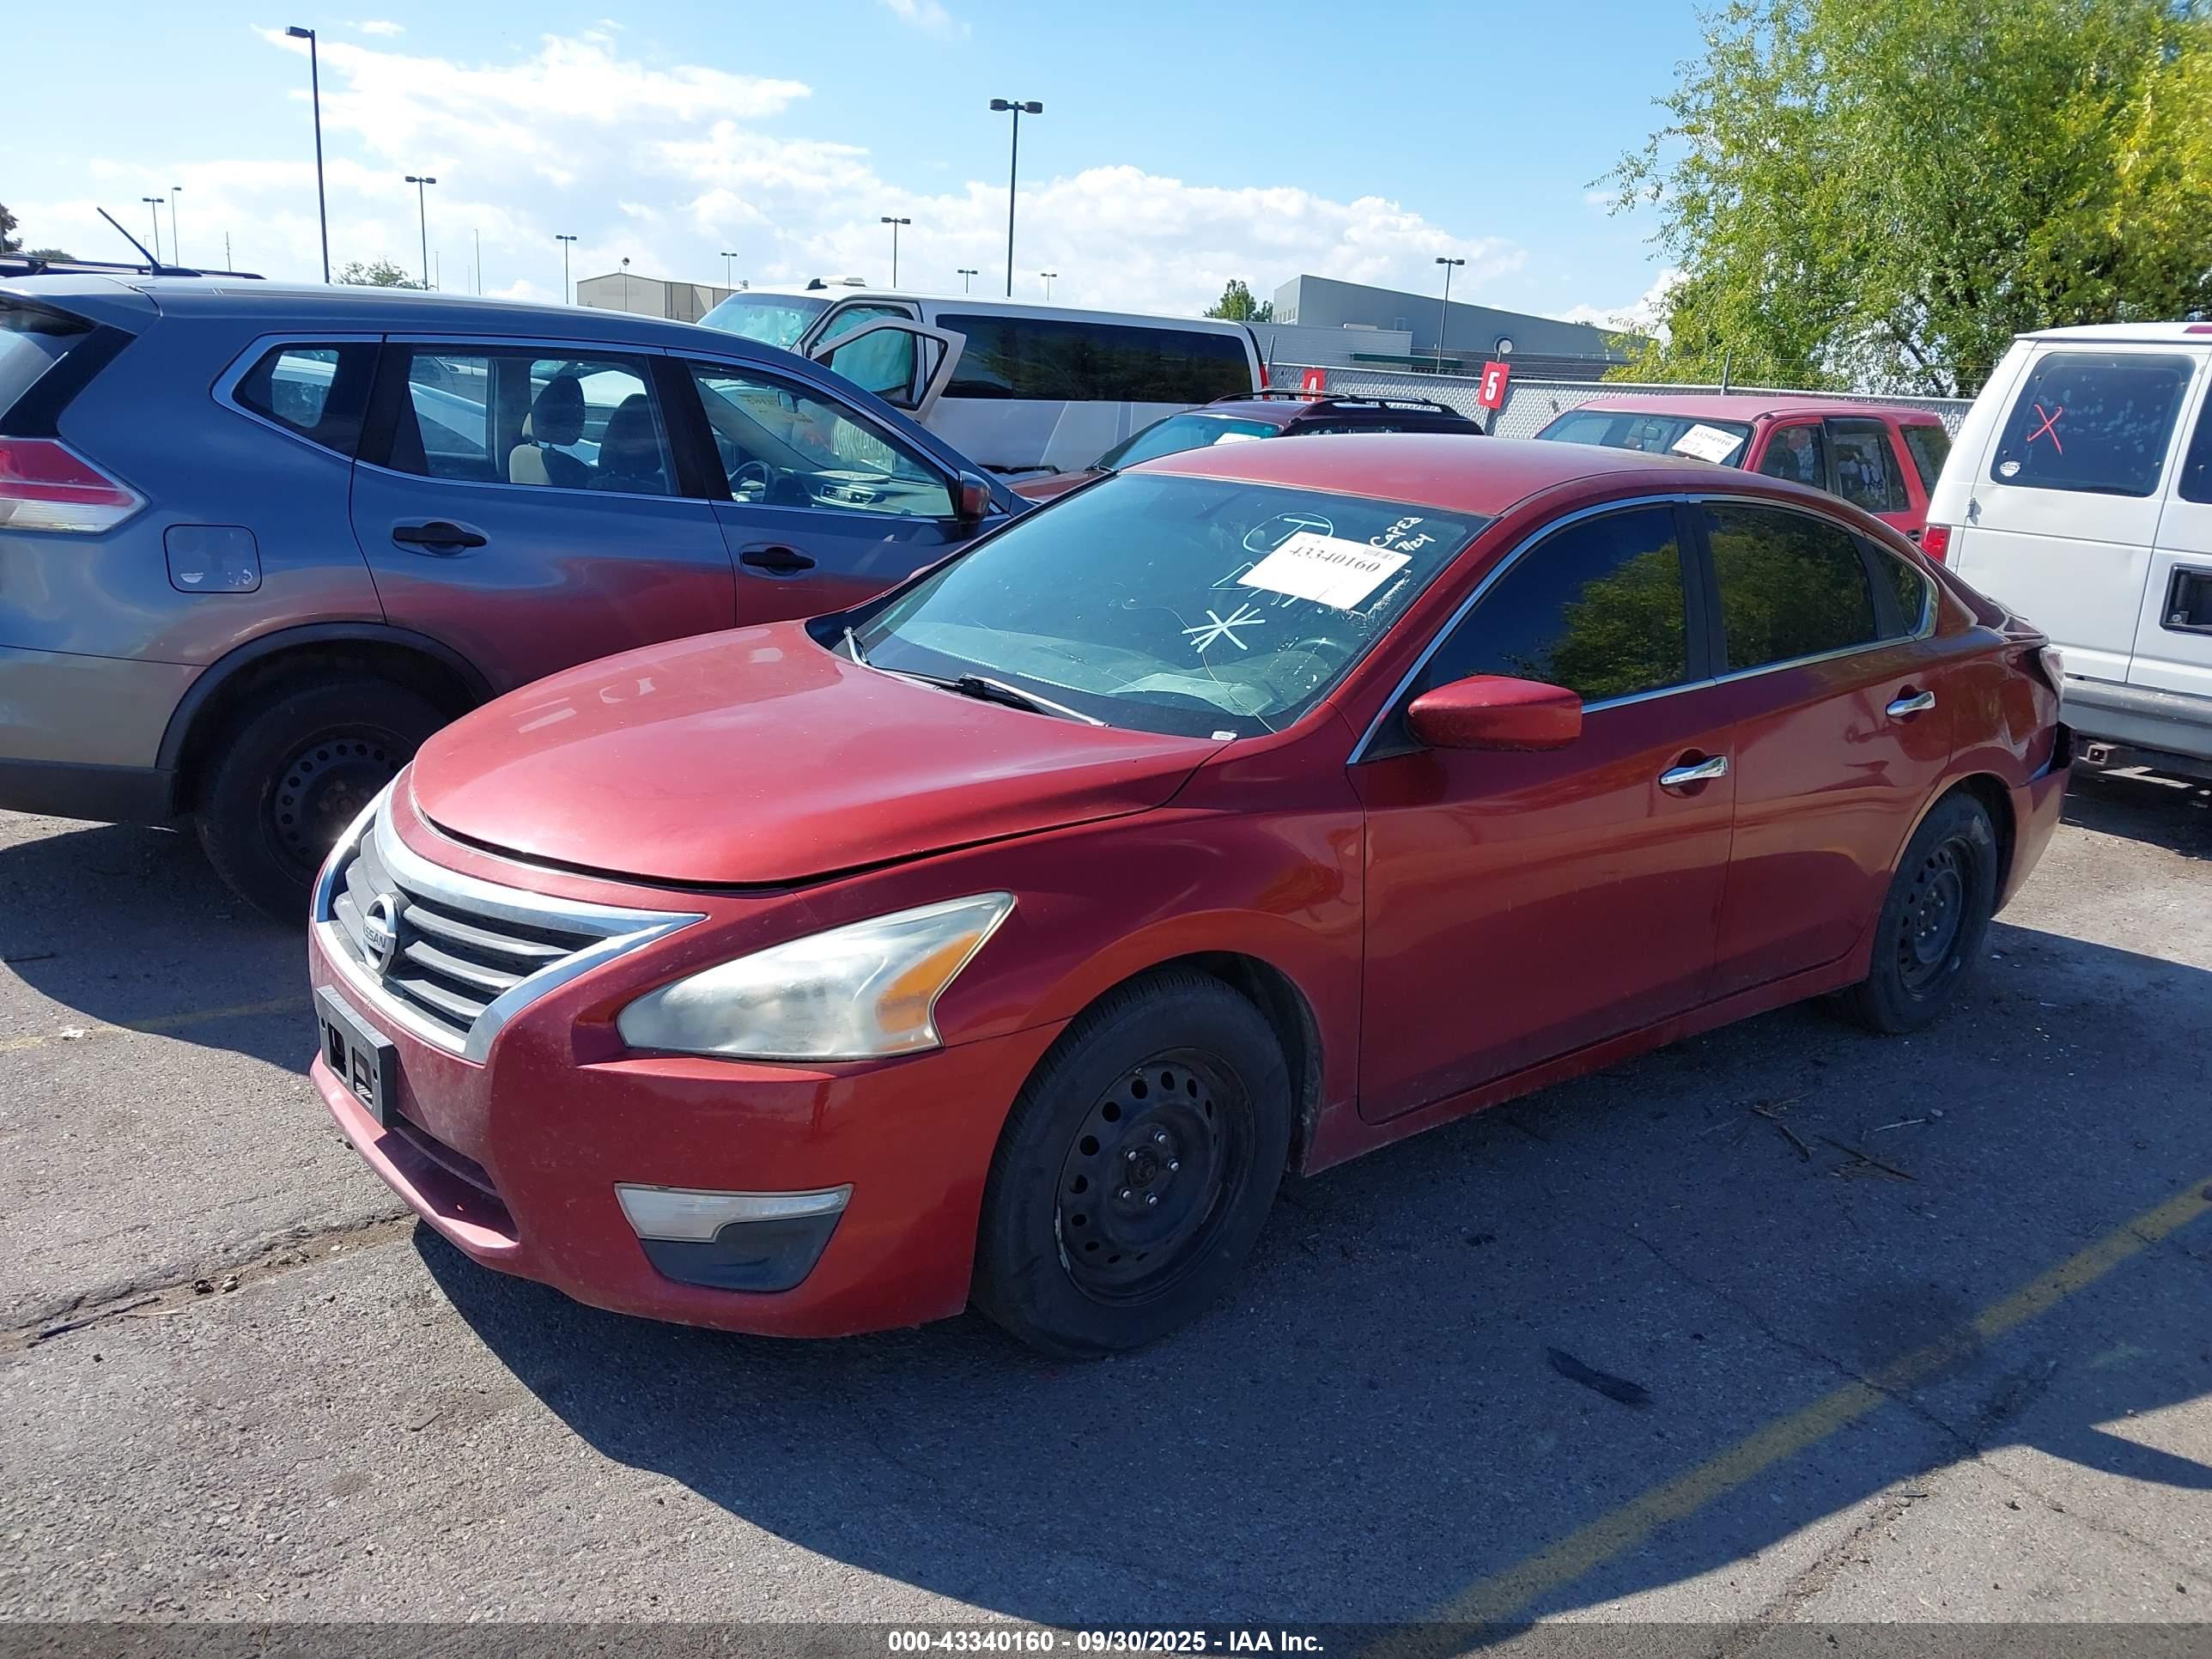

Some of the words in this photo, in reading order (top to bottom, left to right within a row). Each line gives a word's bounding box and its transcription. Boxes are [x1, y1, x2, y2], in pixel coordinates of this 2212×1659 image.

[1308, 377, 1318, 402] 4
[1485, 371, 1500, 401] 5
[1289, 546, 1381, 573] 43340160
